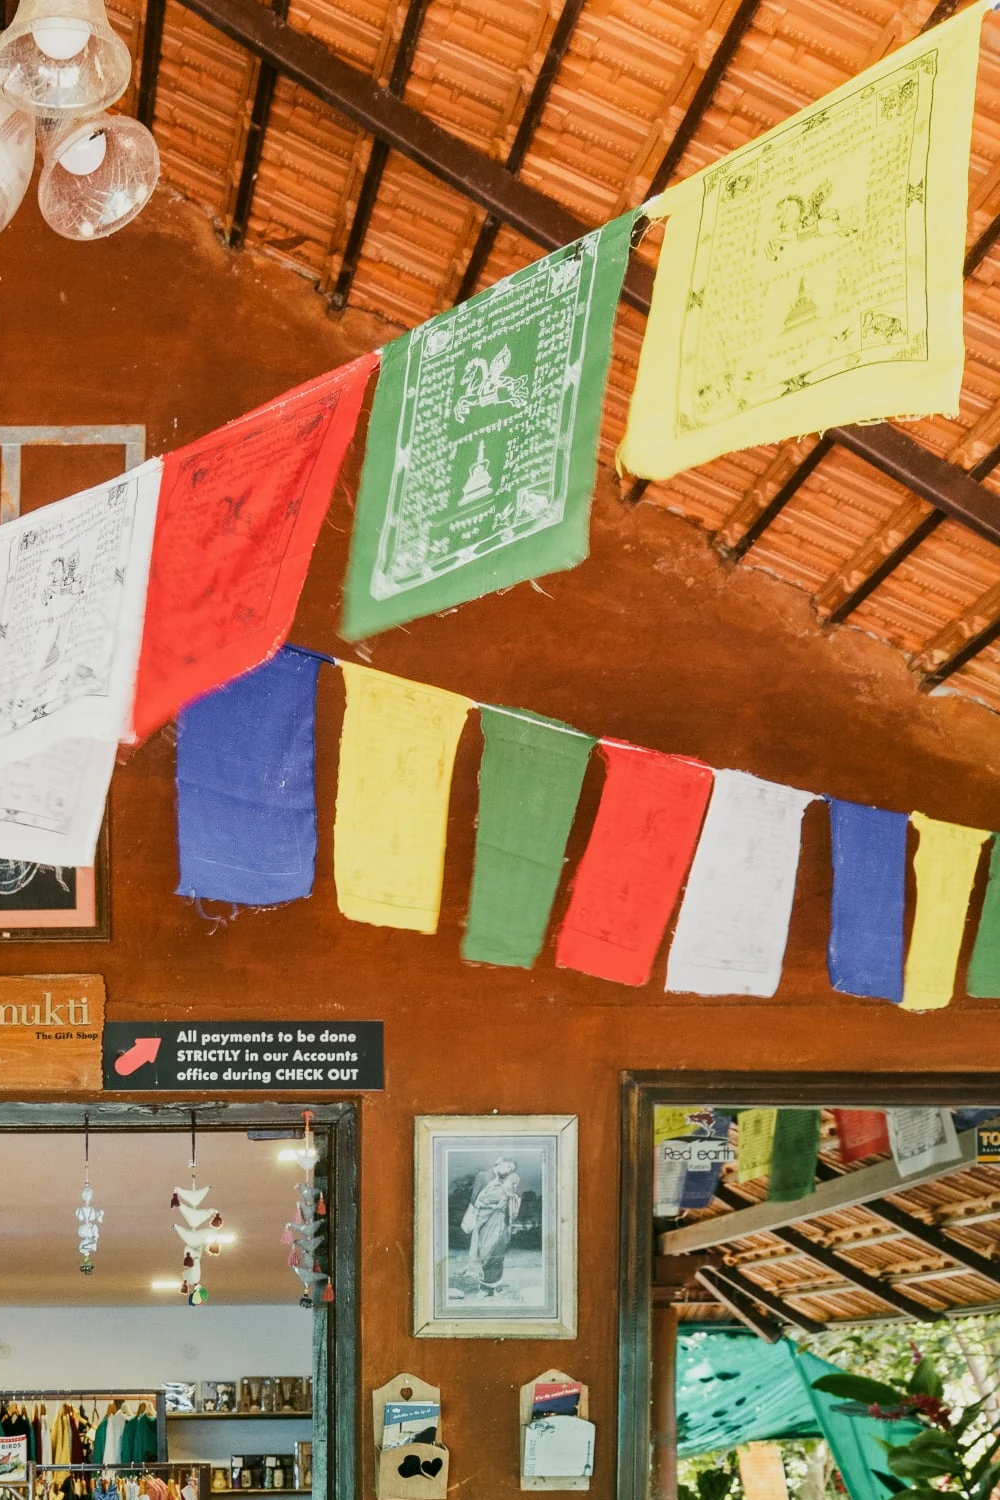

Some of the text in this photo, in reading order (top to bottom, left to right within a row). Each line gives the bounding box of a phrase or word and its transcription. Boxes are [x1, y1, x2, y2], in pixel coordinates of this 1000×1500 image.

[35, 1031, 98, 1041] The Gift Shop
[177, 1030, 357, 1046] All payments to be done
[177, 1050, 358, 1062] STRICTLY in our Accounts
[177, 1068, 359, 1084] office during CHECK OUT
[664, 1146, 736, 1160] Red earth
